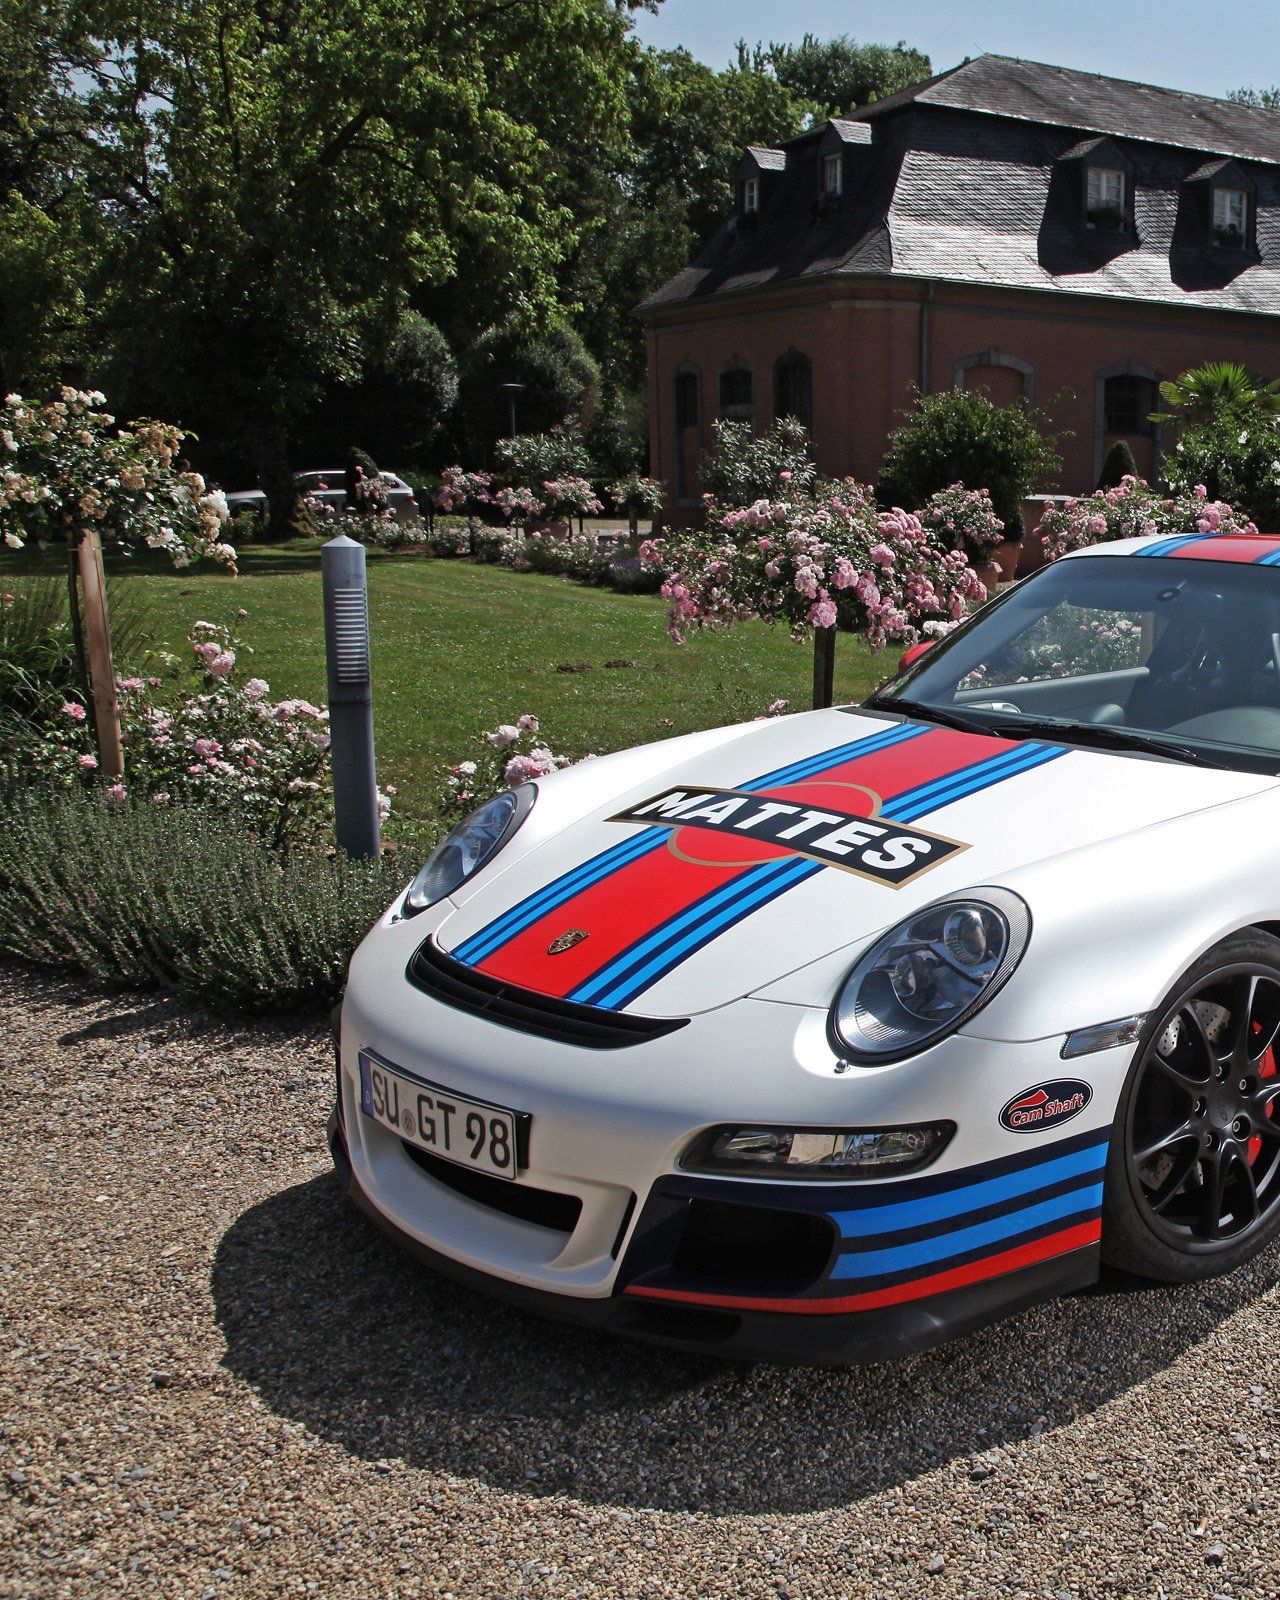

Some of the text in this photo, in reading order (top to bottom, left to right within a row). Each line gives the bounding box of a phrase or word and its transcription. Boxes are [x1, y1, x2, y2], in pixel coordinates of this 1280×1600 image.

[632, 791, 932, 870] MATTES
[372, 1069, 511, 1169] SU GT 98
[1009, 1092, 1085, 1127] Cam Shaft
